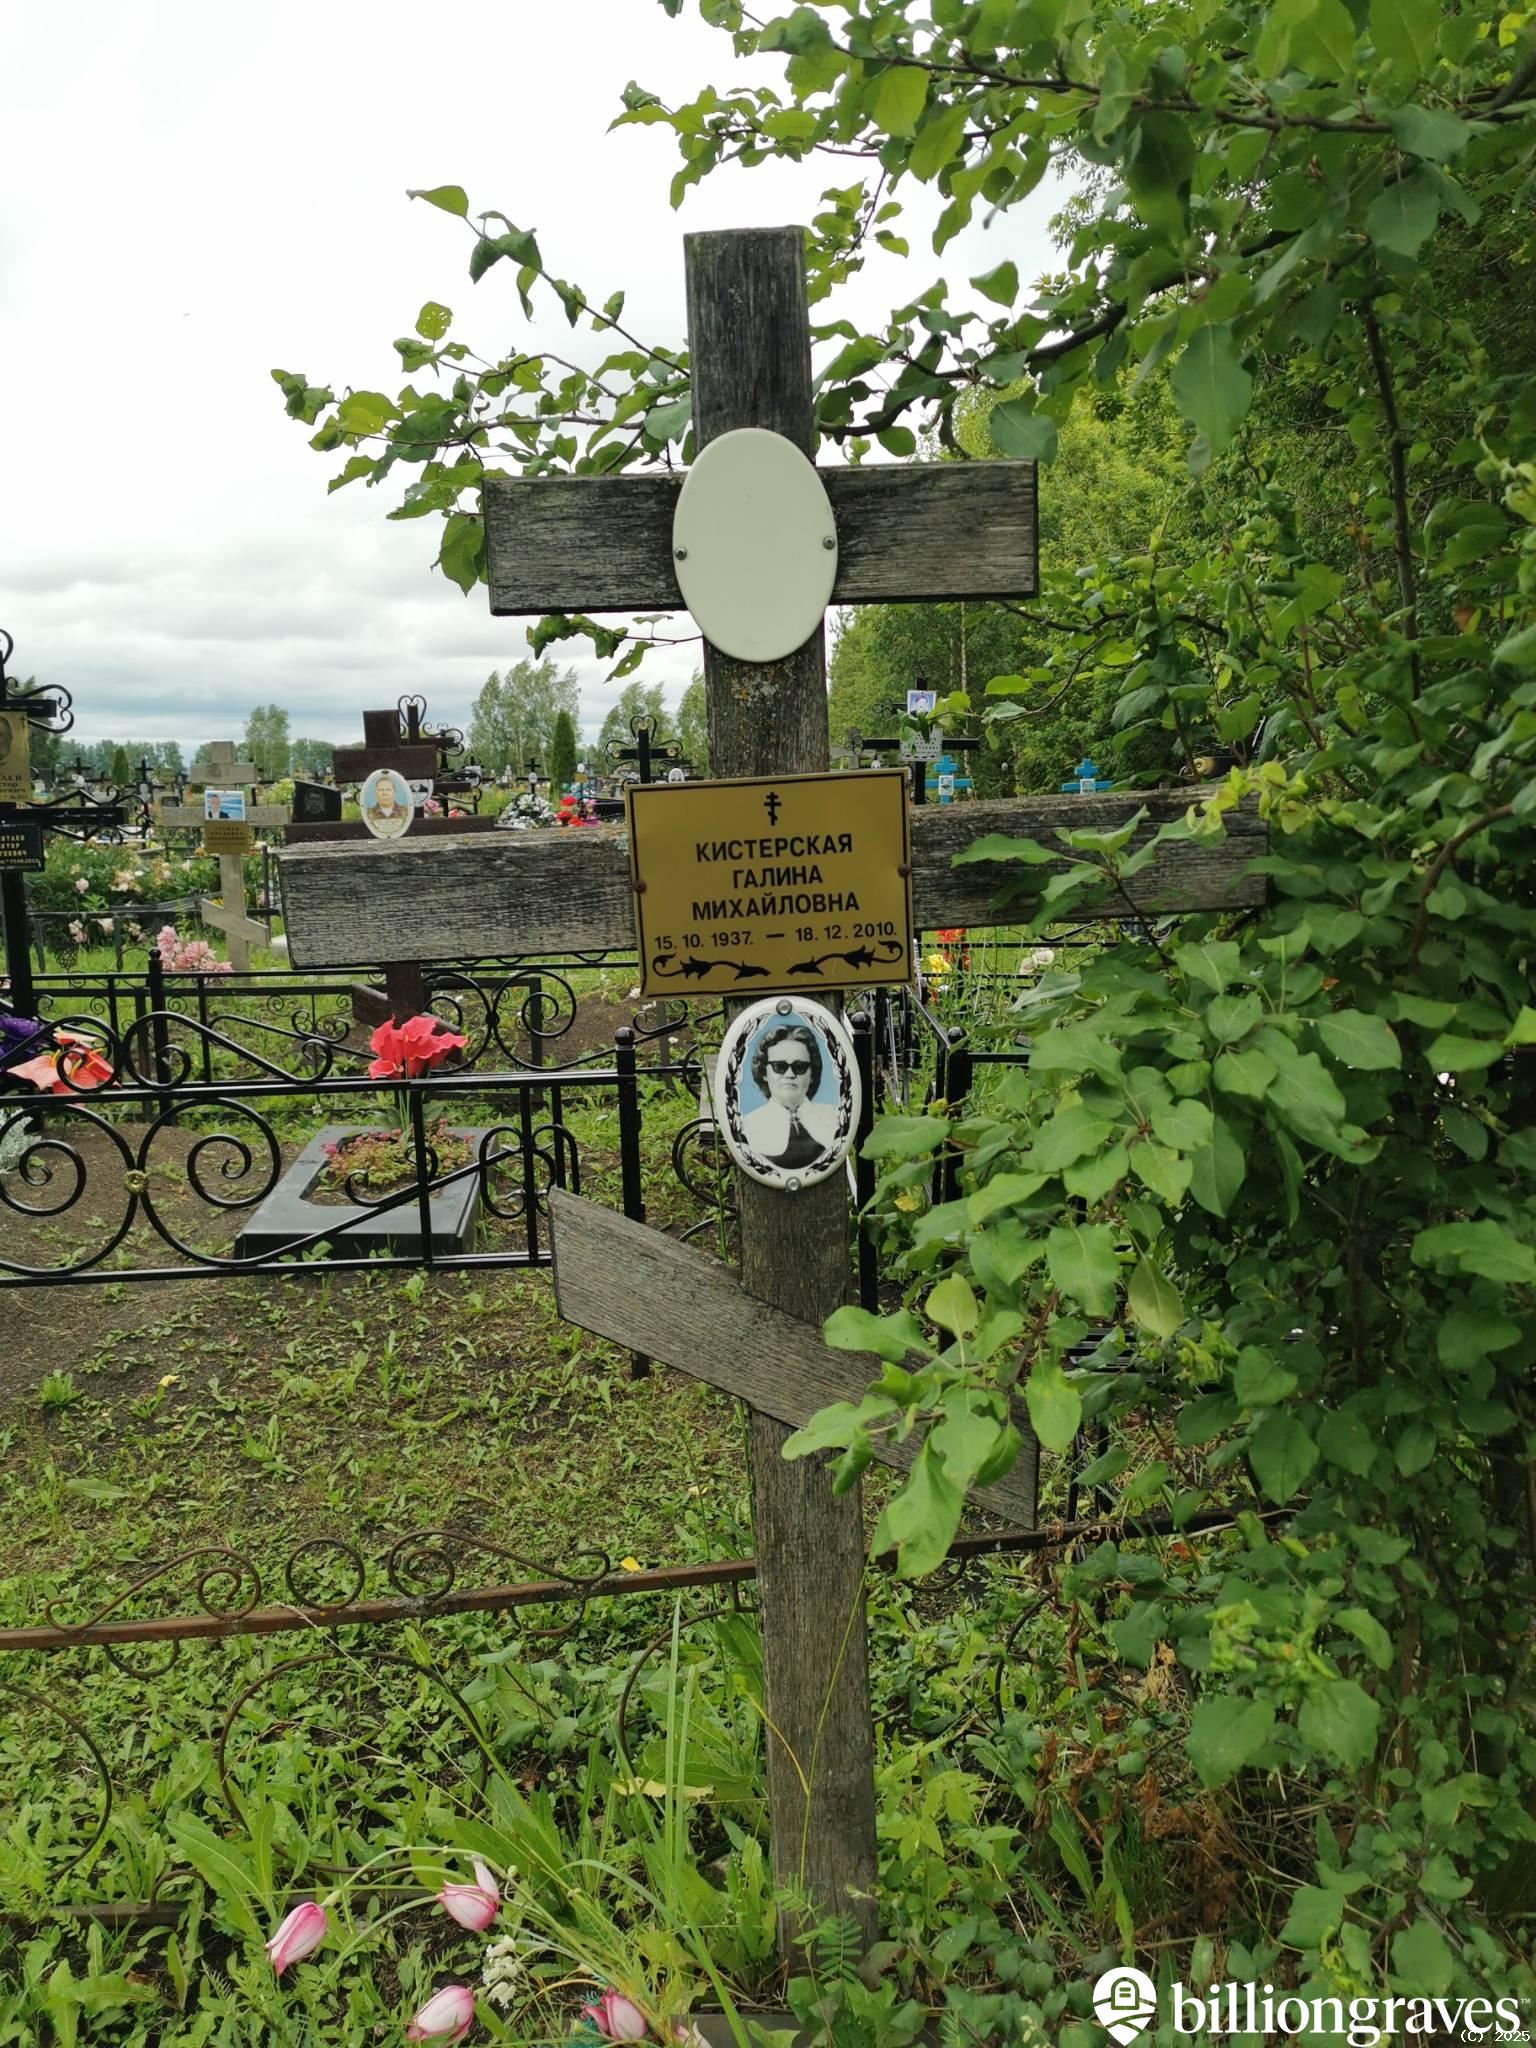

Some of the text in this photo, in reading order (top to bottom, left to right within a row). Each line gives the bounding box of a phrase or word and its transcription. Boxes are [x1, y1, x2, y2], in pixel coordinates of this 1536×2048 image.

[696, 833, 853, 862] КИСТЕРСКАЯ
[733, 865, 823, 889] ГАЛИНА
[692, 892, 860, 921] МИХАЙЛОВНА
